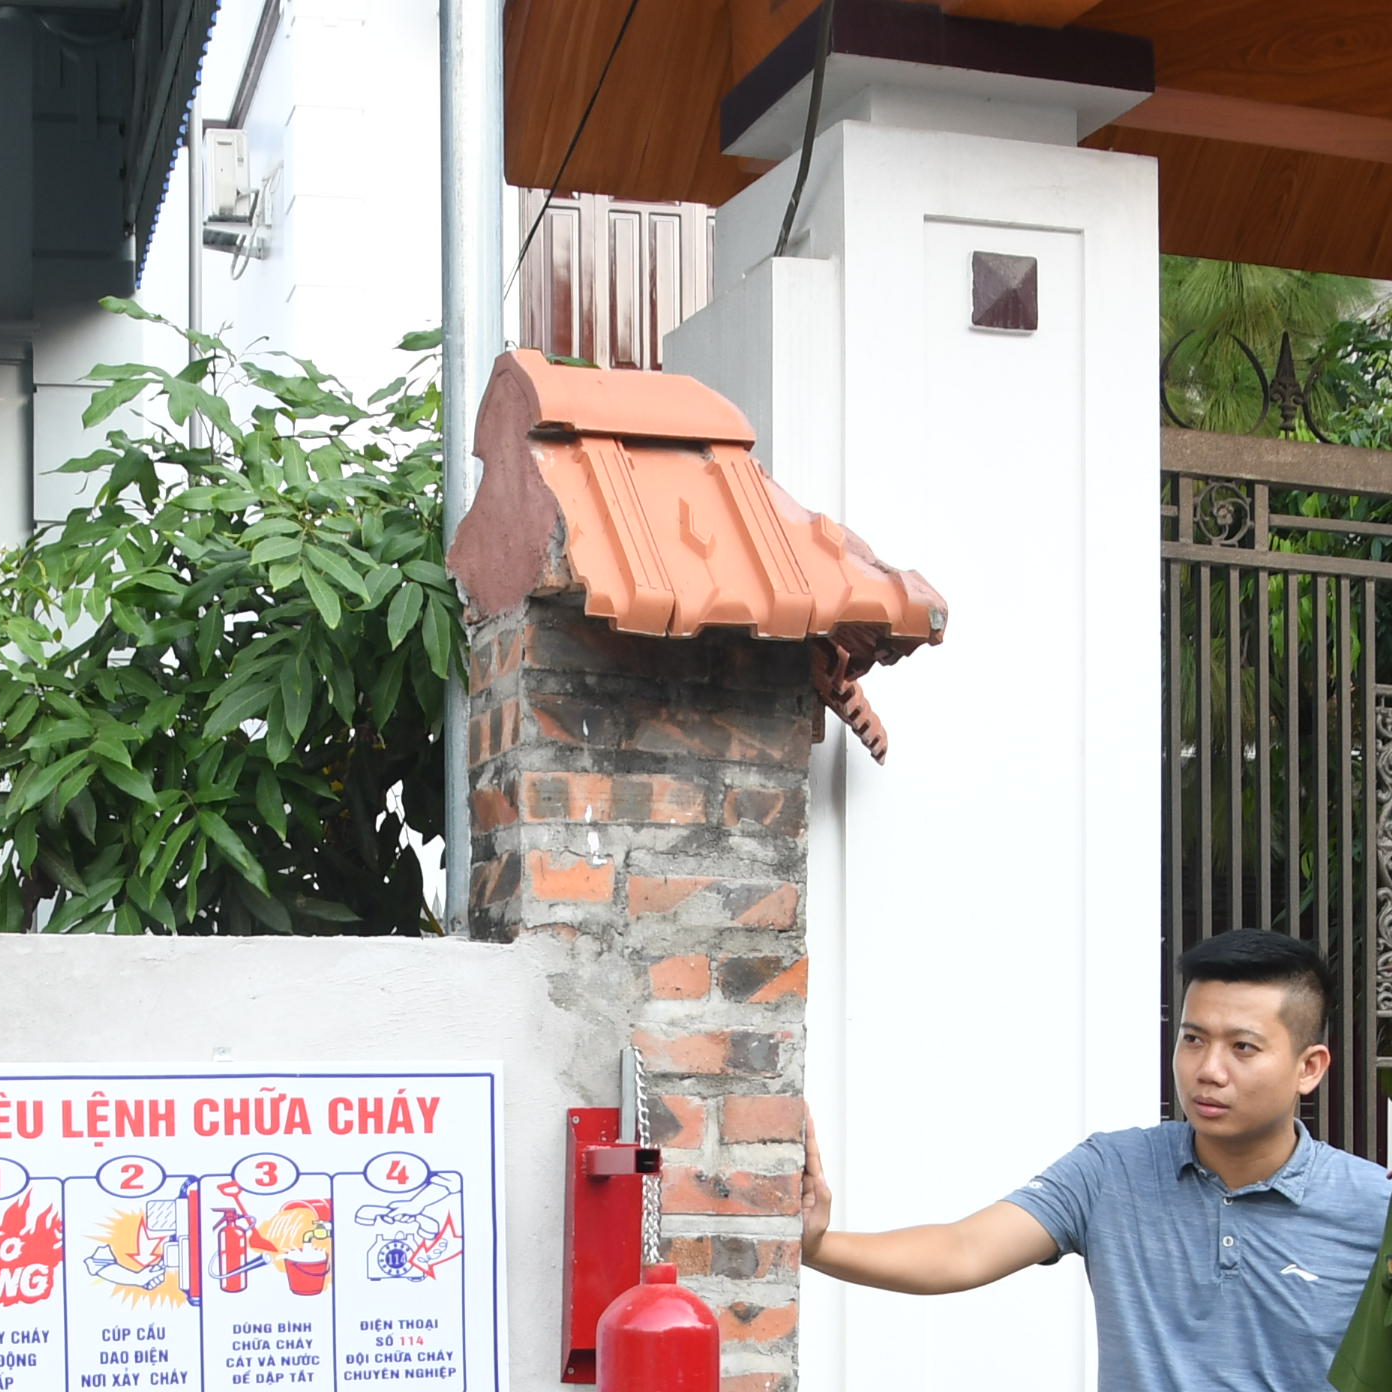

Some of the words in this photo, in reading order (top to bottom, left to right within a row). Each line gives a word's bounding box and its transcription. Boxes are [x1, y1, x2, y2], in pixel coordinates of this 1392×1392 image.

[61, 1091, 175, 1147] LỆNH
[193, 1087, 312, 1136] CHỮA
[328, 1089, 440, 1135] CHÁY
[120, 1164, 144, 1189] 2
[255, 1161, 278, 1187] 3
[386, 1160, 409, 1185] 4
[102, 1325, 131, 1342] CÚP
[277, 1320, 312, 1333] BÌNH
[360, 1318, 393, 1332] ĐIỆN
[398, 1319, 439, 1331] THOẠI
[11, 1327, 50, 1344] CHÁY
[232, 1338, 270, 1351] CHỮA
[276, 1337, 313, 1350] CHÁY
[375, 1332, 394, 1347] SỐ
[399, 1336, 424, 1346] 114
[100, 1351, 129, 1365] DAO
[134, 1347, 168, 1366] ĐIỆN
[226, 1356, 253, 1368] CÁT
[258, 1354, 276, 1367] VÀ
[281, 1353, 320, 1366] NƯỚC
[346, 1352, 369, 1366] ĐỘI
[374, 1350, 412, 1364] CHỮA
[417, 1350, 454, 1362] CHÁY
[81, 1373, 106, 1388] NƠI
[112, 1367, 140, 1387] XẢY
[150, 1370, 188, 1386] CHÁY
[344, 1368, 400, 1381] CHUYÊN
[404, 1366, 457, 1380] NGHIỆP
